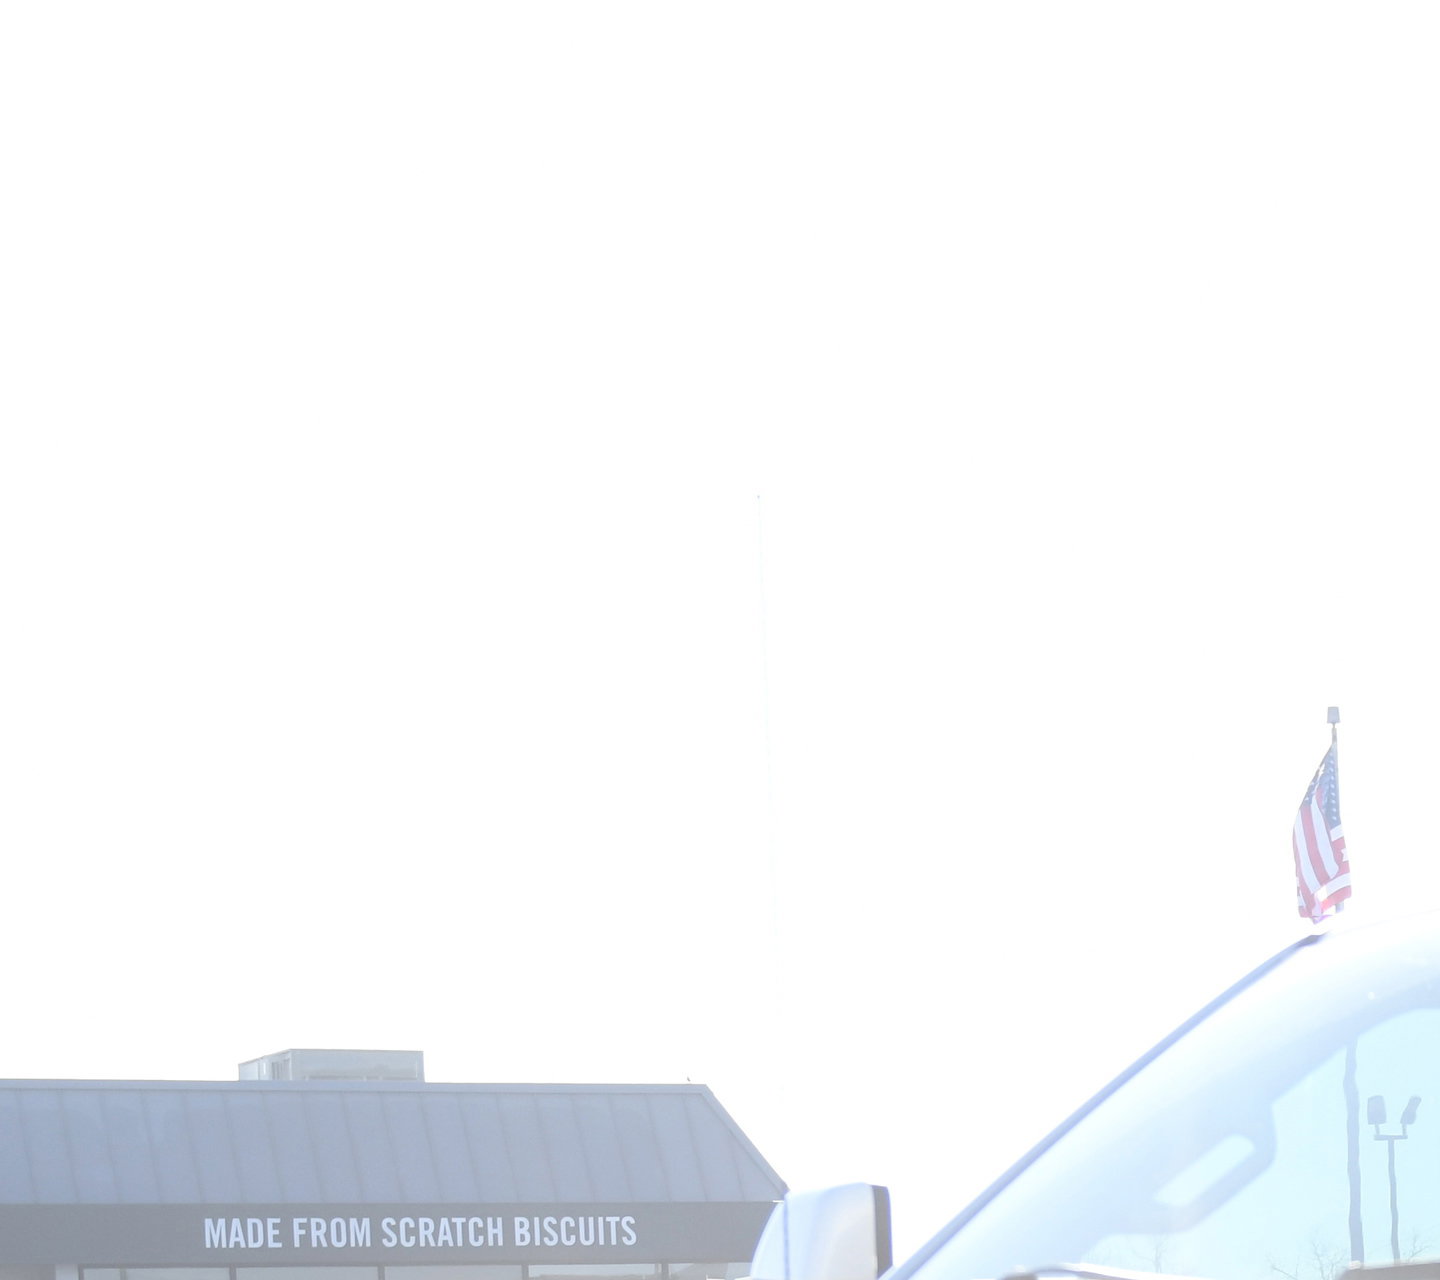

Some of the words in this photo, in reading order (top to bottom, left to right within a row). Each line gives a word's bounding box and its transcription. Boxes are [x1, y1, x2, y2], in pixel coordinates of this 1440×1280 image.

[204, 1217, 282, 1249] MADE
[293, 1217, 371, 1248] FROM
[381, 1217, 504, 1248] SCRATCH
[513, 1216, 637, 1247] BISCUITS
